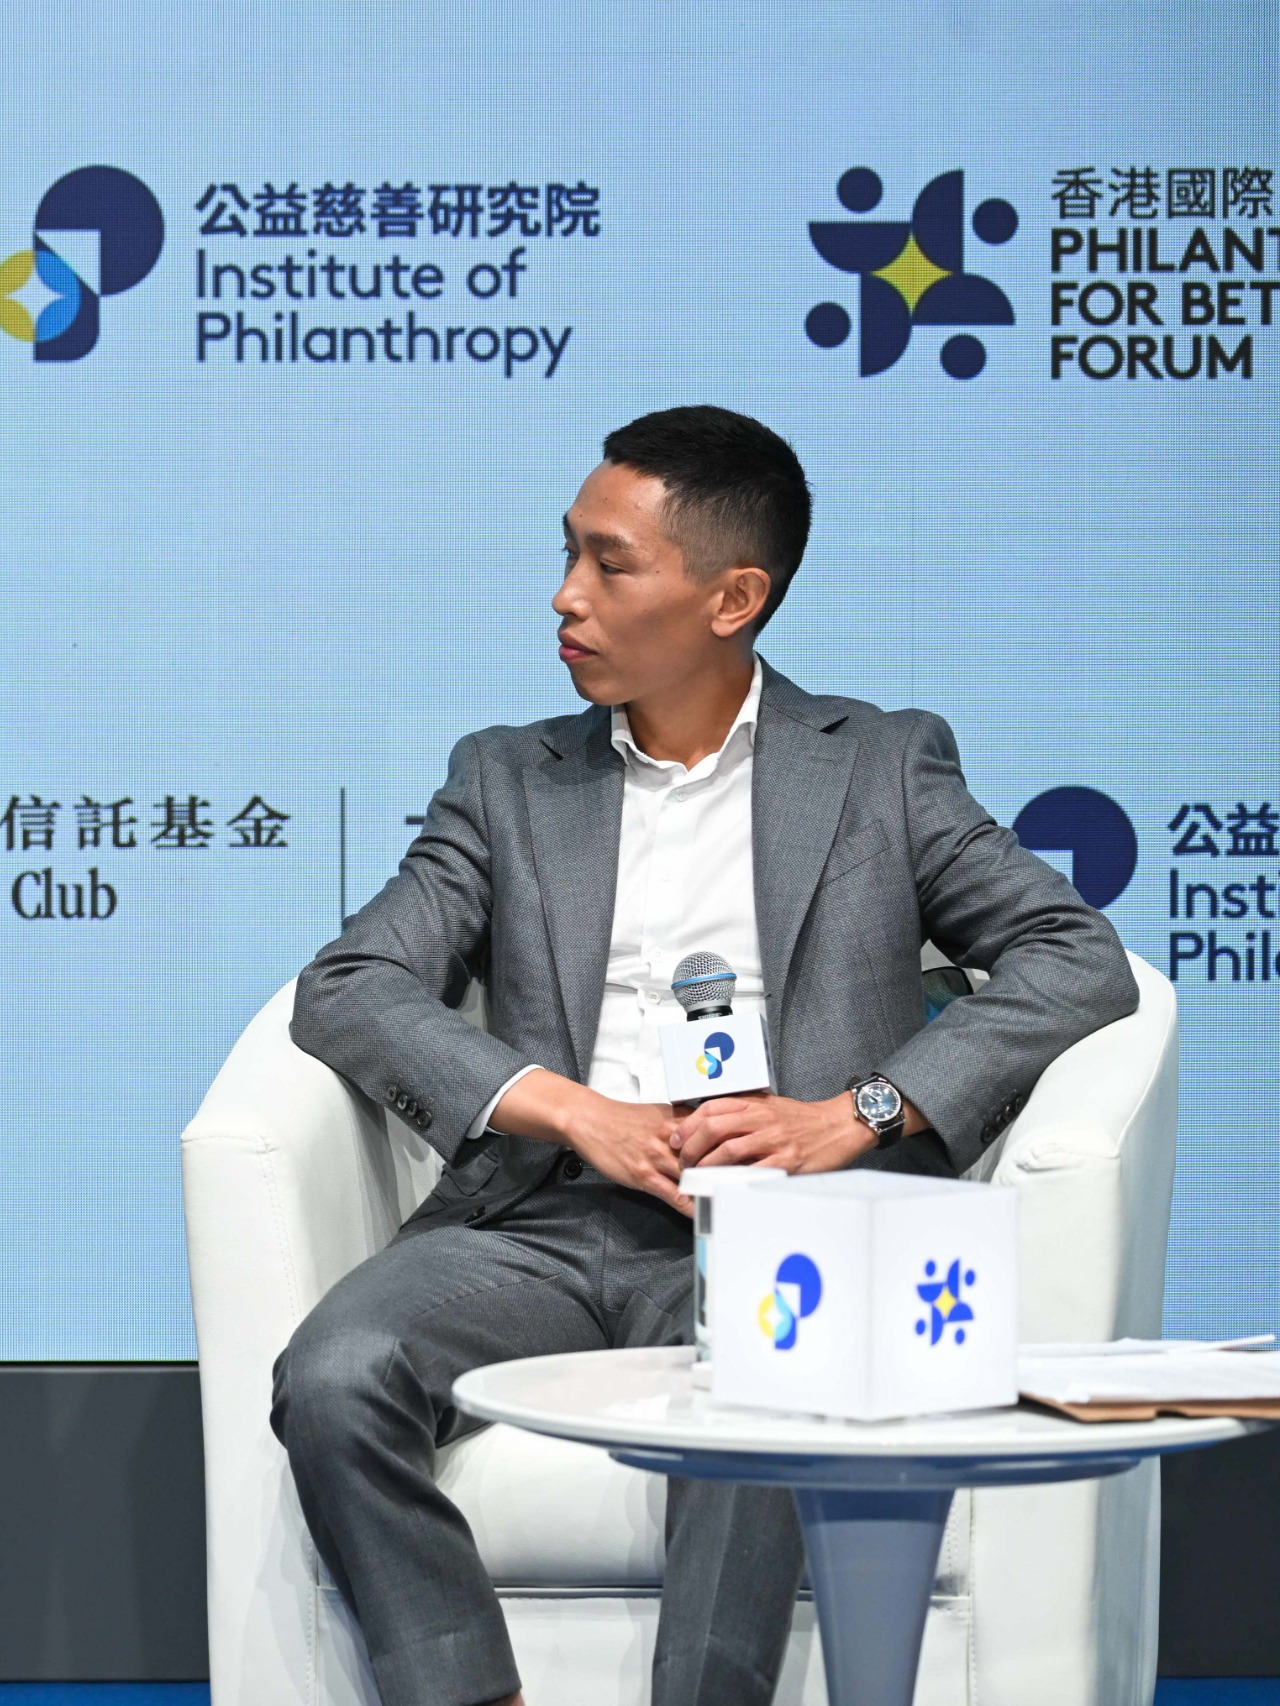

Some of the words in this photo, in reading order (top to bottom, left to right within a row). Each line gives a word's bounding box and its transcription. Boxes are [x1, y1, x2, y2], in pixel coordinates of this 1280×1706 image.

[195, 180, 602, 238] 公益慈善研究院
[1051, 166, 1274, 221] 香港國際
[196, 247, 445, 300] Institute
[466, 245, 527, 299] of
[1051, 281, 1165, 327] FOR
[1181, 281, 1280, 327] BET
[196, 310, 574, 378] Philanthropy
[1051, 333, 1254, 381] FORUM
[1169, 802, 1280, 857] 公益
[11, 866, 118, 920] Club
[1169, 931, 1280, 982] Phil
